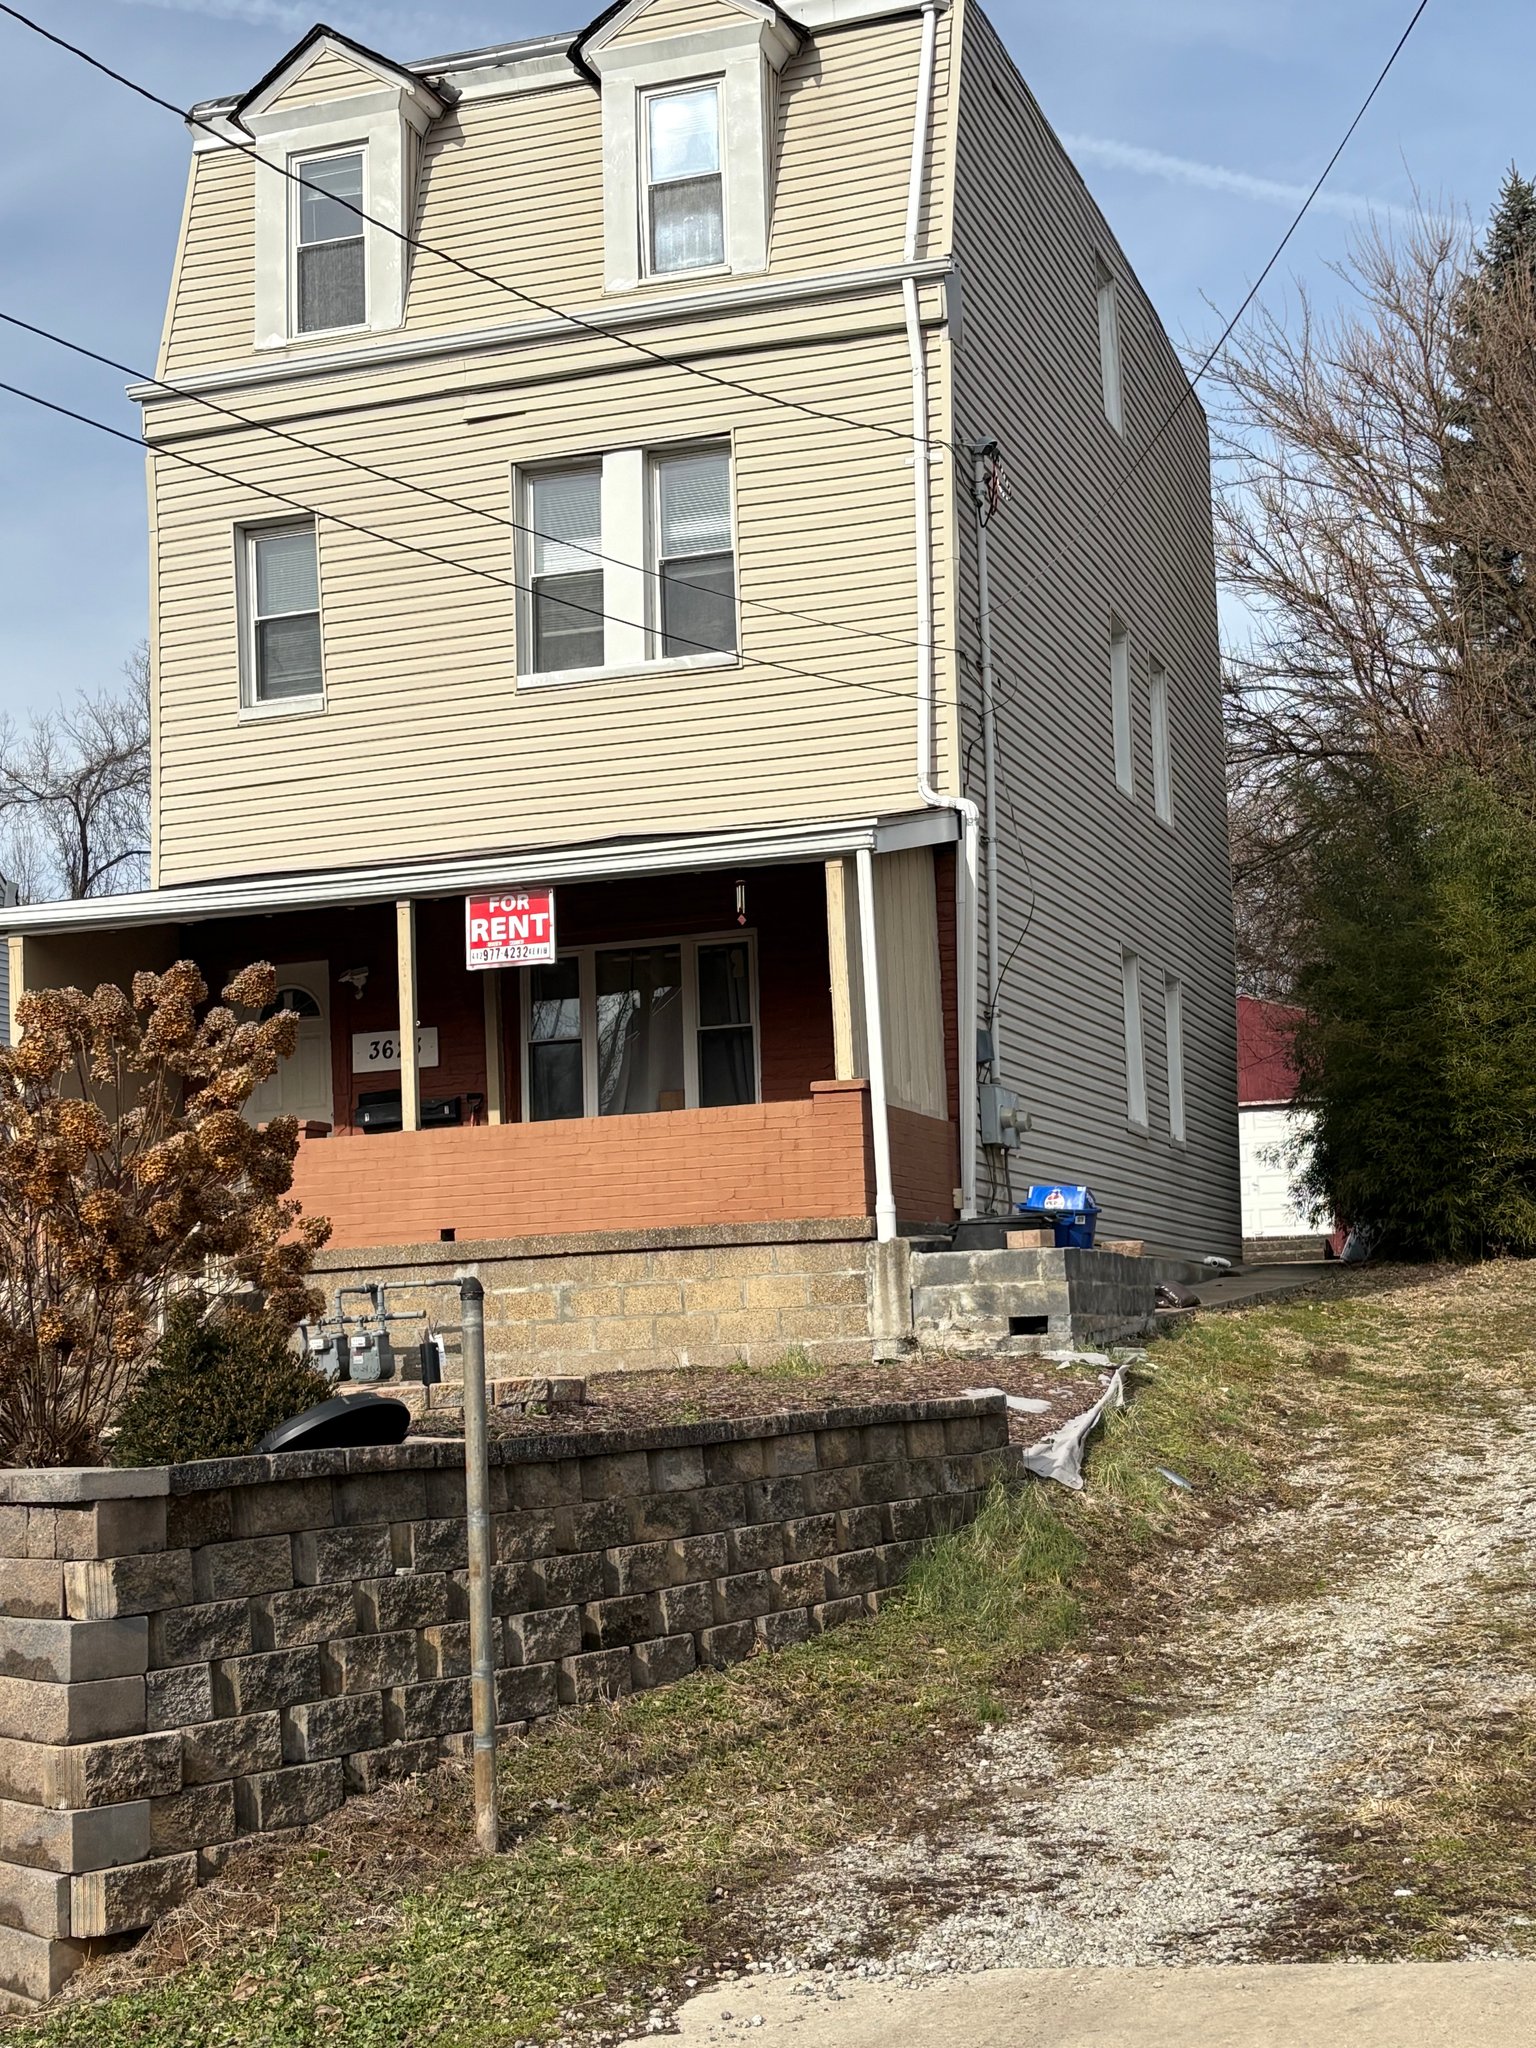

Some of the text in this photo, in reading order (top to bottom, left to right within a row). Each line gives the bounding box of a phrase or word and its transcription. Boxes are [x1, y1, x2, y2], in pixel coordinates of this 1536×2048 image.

[489, 894, 530, 913] FOR
[471, 912, 549, 943] RENT
[368, 1037, 422, 1060] 36
